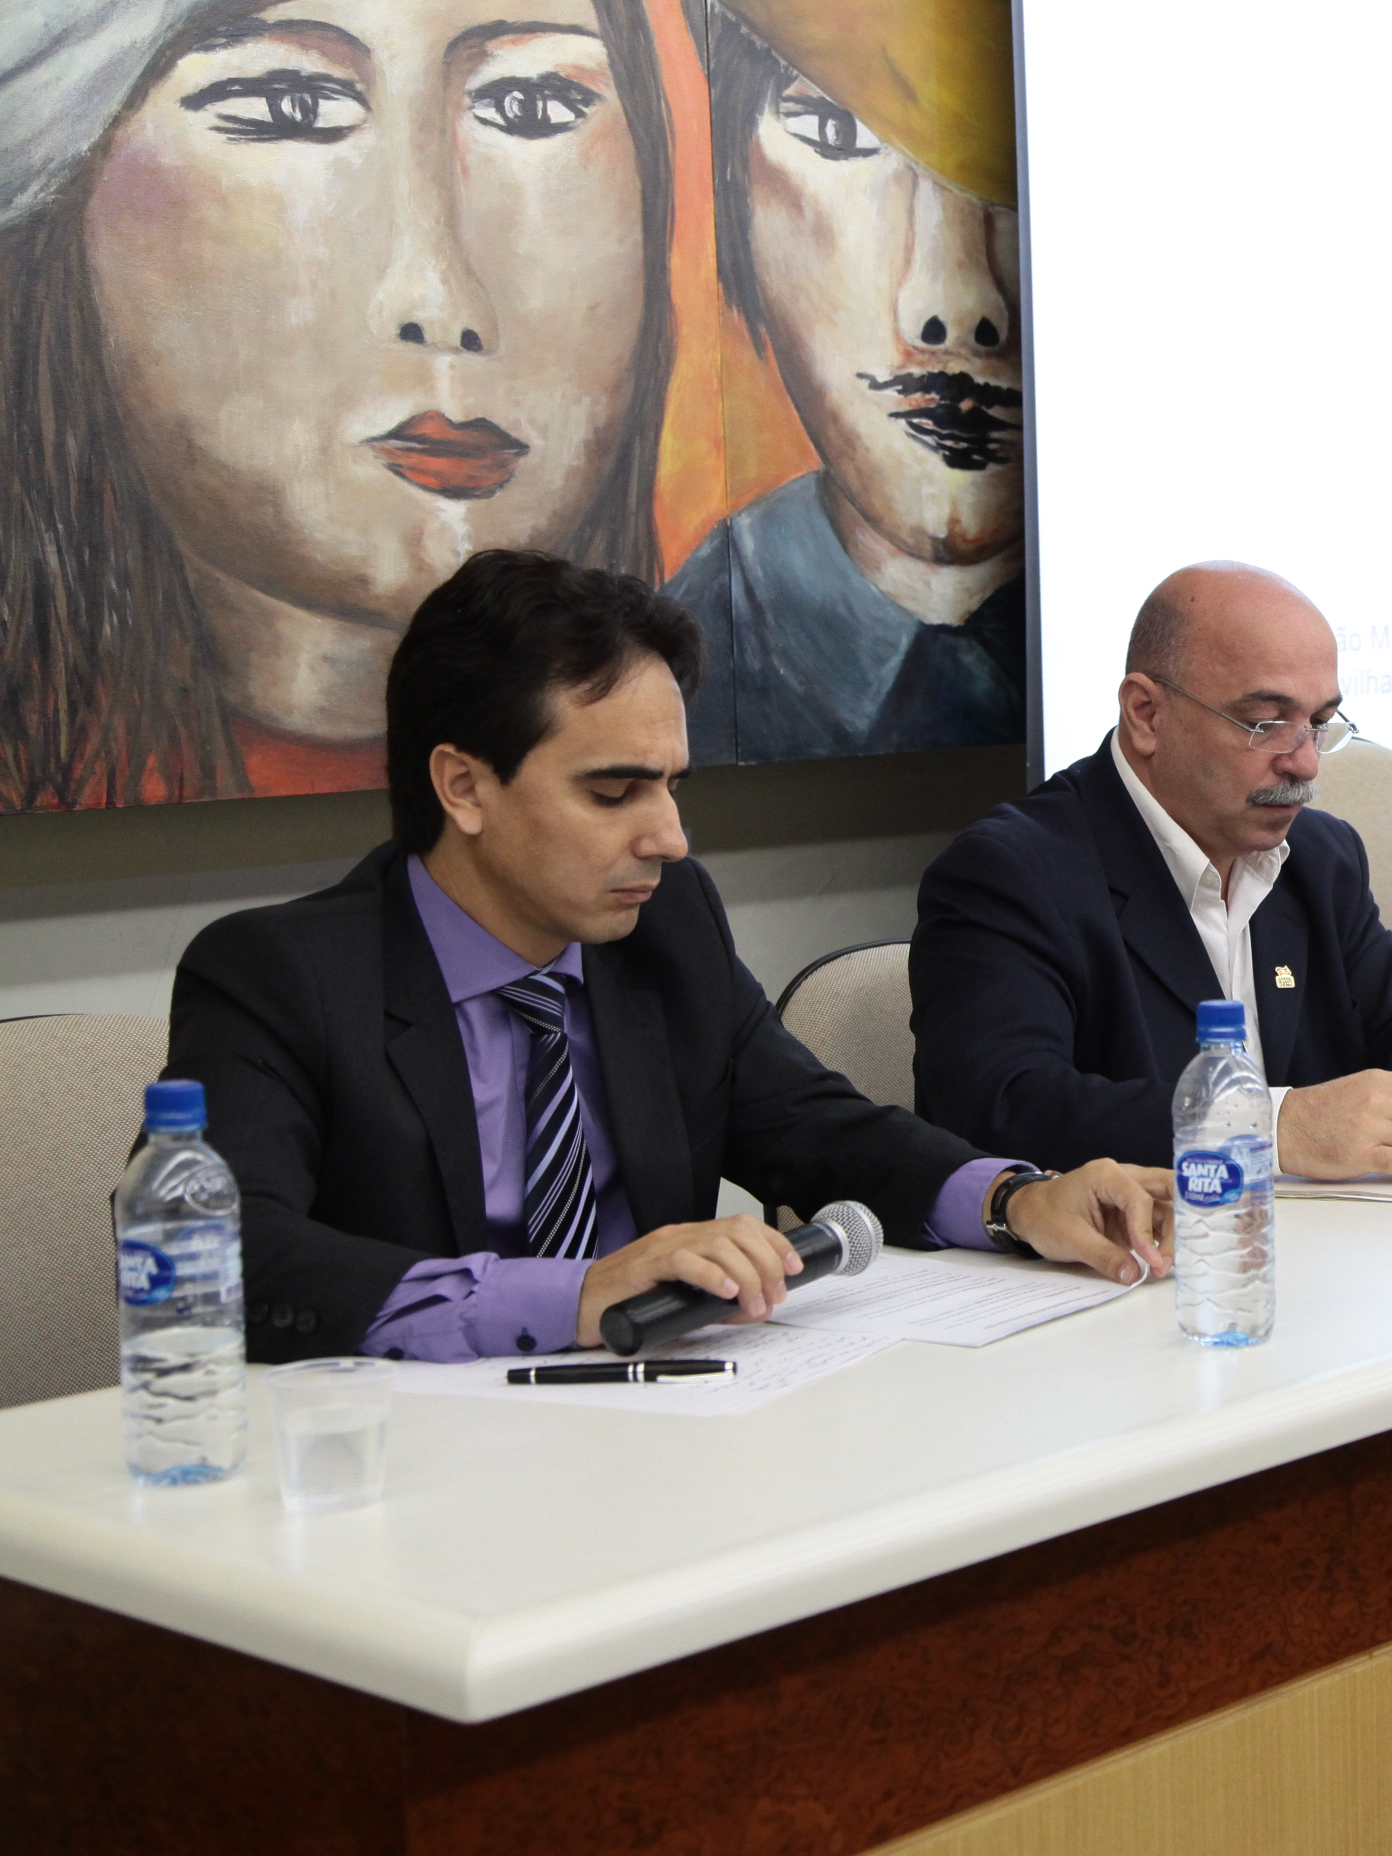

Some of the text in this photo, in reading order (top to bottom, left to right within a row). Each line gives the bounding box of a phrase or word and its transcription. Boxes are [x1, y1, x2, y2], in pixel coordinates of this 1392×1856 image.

[1336, 626, 1363, 653] ão
[1181, 1160, 1229, 1180] SANTA
[1188, 1176, 1223, 1194] RITA
